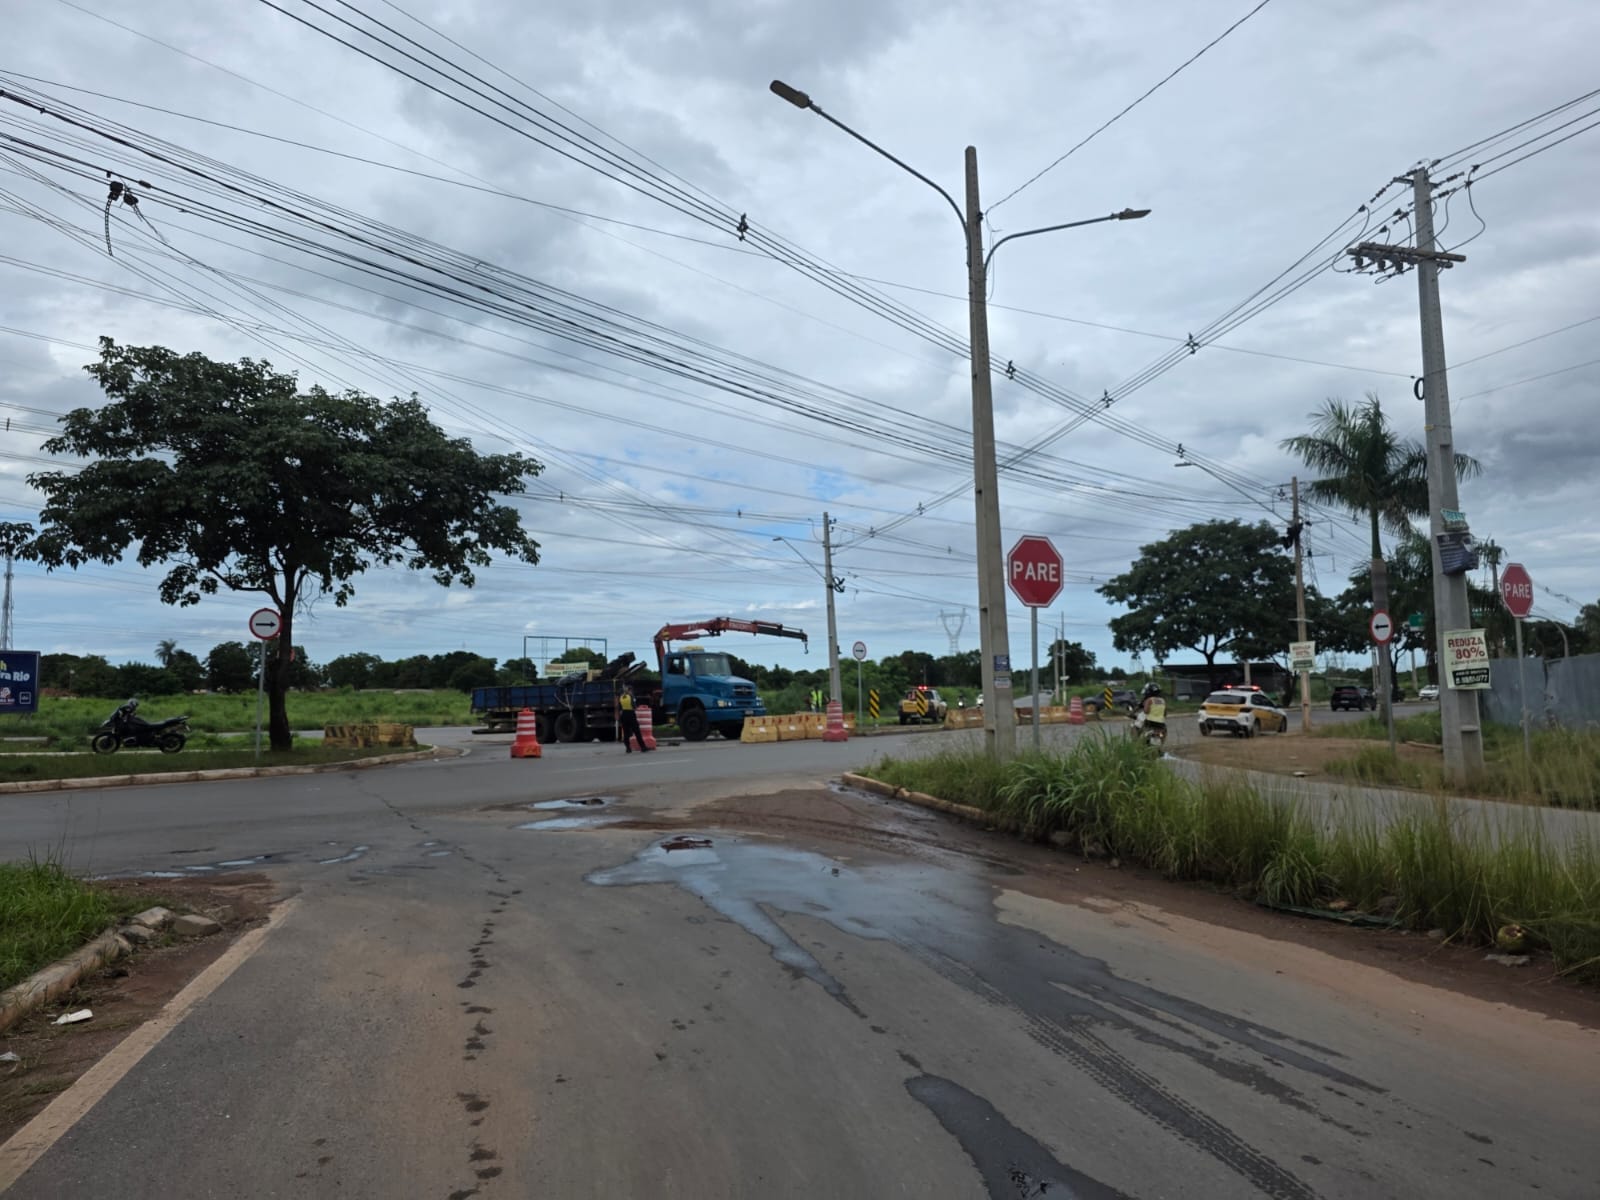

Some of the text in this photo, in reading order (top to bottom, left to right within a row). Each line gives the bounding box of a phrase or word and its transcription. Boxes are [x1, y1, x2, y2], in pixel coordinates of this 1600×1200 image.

[1013, 561, 1058, 581] PARE
[1505, 583, 1530, 598] PARE
[1448, 637, 1484, 648] REDUZA
[1456, 647, 1485, 659] 80%
[13, 671, 30, 681] Rio
